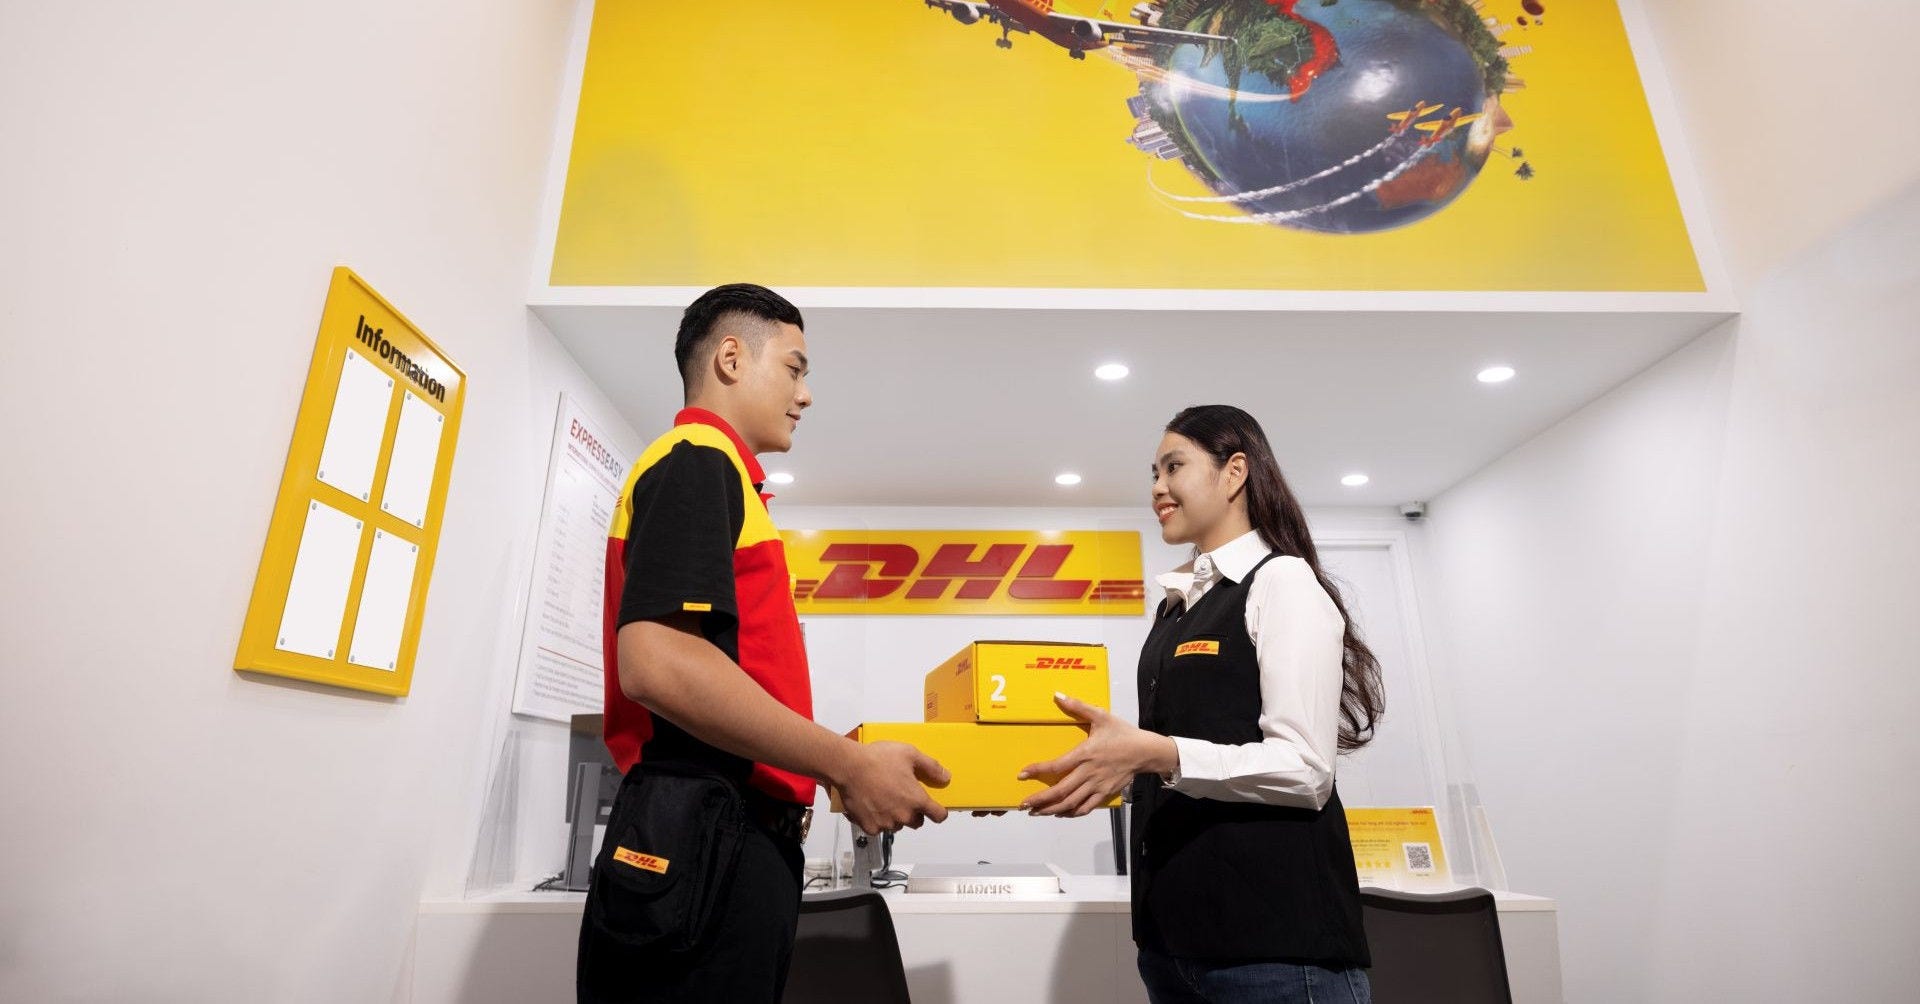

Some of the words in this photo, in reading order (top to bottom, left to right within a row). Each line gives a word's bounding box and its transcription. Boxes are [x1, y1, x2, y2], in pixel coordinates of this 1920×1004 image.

[356, 314, 445, 403] Information
[570, 418, 623, 480] EXPRESSEASY
[812, 543, 1092, 600] DHL
[1180, 643, 1210, 653] DHL
[1036, 657, 1083, 669] DHL
[991, 674, 1006, 702] 2
[625, 852, 658, 868] DHL
